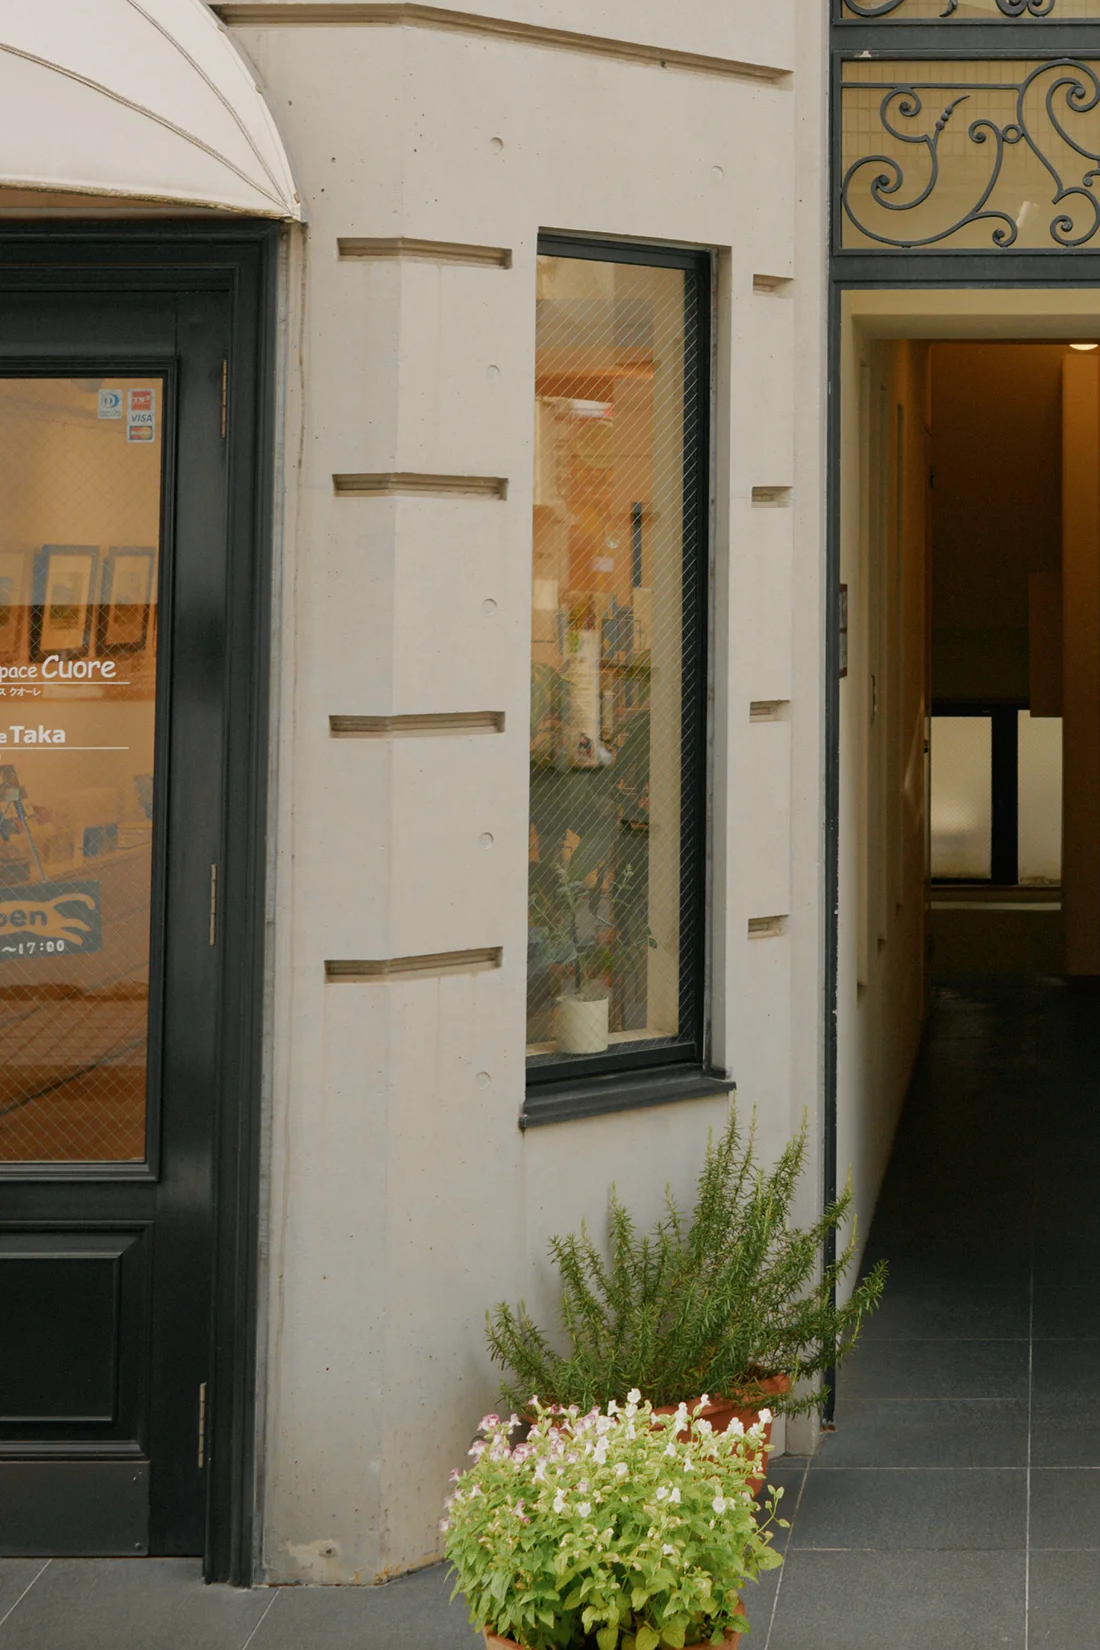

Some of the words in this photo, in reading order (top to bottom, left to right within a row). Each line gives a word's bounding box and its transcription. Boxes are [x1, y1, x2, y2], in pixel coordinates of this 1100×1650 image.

[131, 414, 153, 423] VISA
[41, 654, 117, 679] Cuore
[9, 687, 41, 697] クオーレ
[9, 724, 66, 744] Taka
